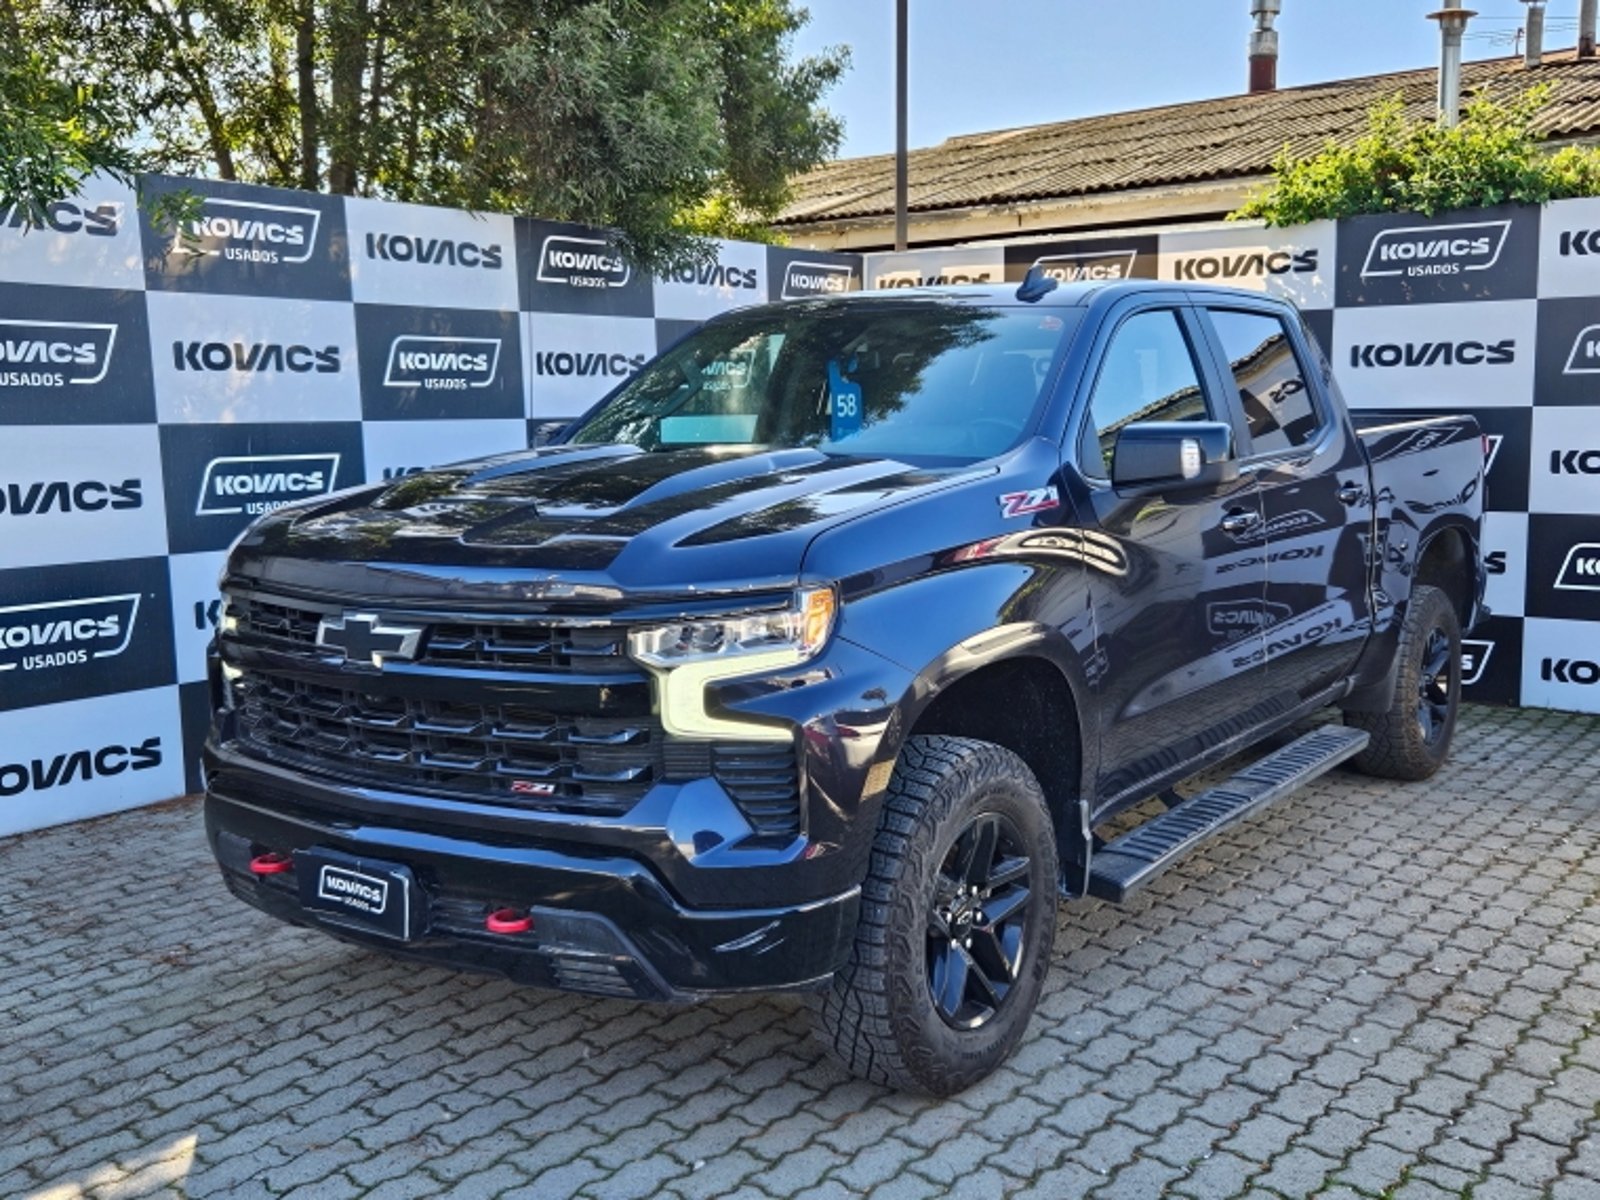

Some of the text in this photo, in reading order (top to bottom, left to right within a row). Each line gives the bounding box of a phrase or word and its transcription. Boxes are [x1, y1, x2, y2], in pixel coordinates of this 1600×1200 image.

[192, 216, 304, 245] KOVACS
[224, 247, 279, 264] USADOS
[366, 232, 503, 270] KOVACS
[549, 249, 624, 272] KOVACS
[1380, 237, 1490, 261] KOVACS
[1174, 249, 1319, 281] KOVACS
[1407, 263, 1460, 276] USADOS
[0, 340, 97, 364] VACS
[173, 341, 341, 373] KOVACS
[399, 352, 488, 372] KOVACS
[1350, 339, 1516, 368] KOVACS
[0, 372, 64, 386] USADOS
[424, 378, 468, 390] USADOS
[837, 393, 857, 417] 58
[215, 471, 324, 496] KOVACS
[0, 479, 143, 516] VACS
[1000, 485, 1061, 519] Z71
[0, 615, 120, 650] OVACS
[22, 650, 88, 670] USADOS
[326, 875, 382, 903] KOVACS
